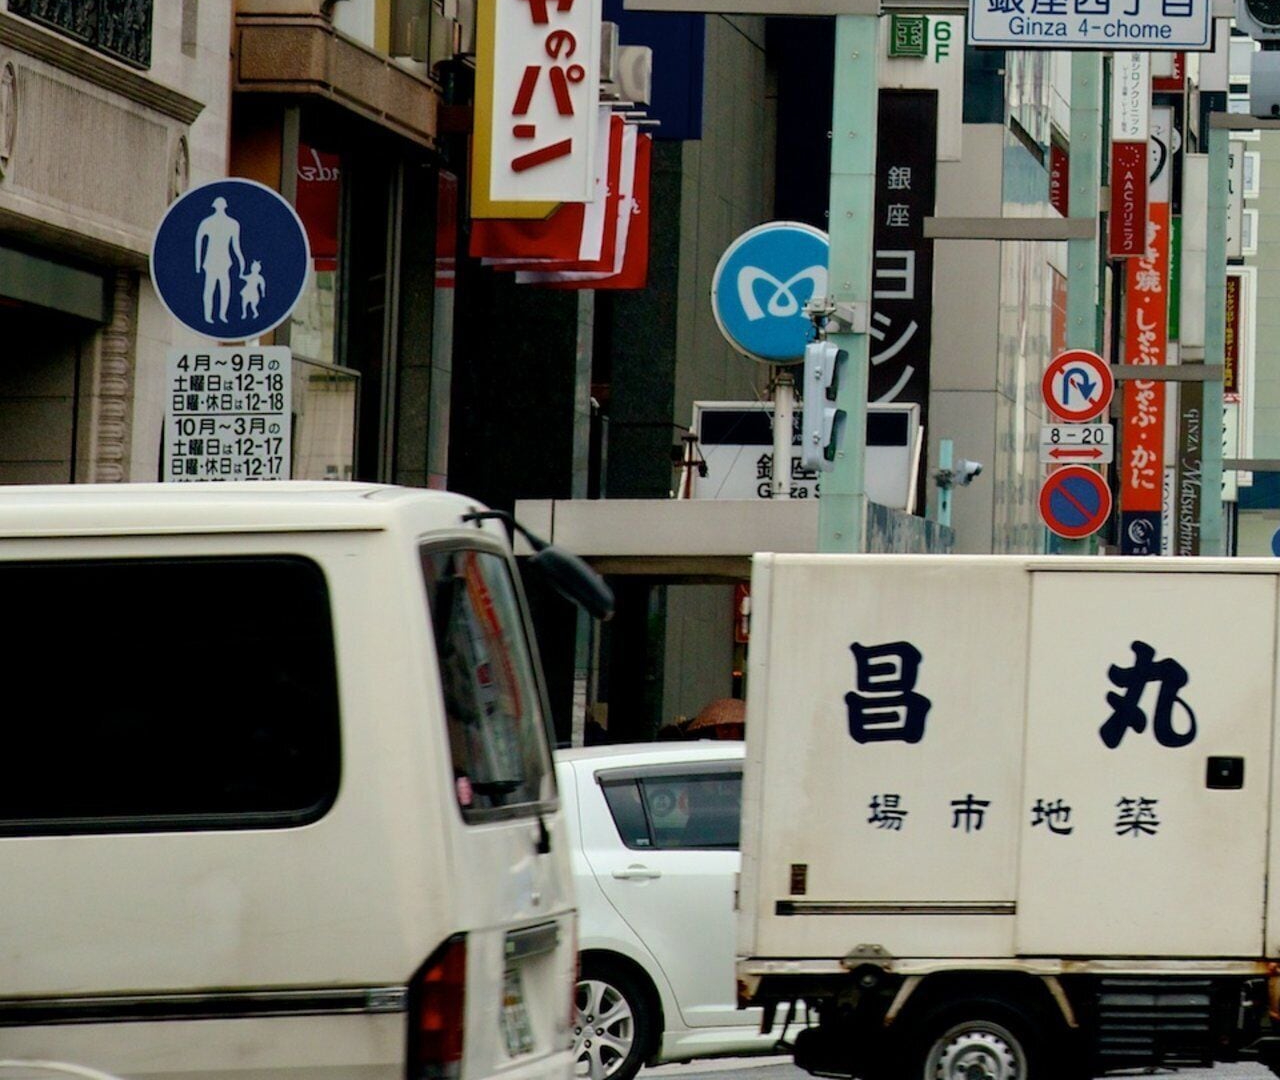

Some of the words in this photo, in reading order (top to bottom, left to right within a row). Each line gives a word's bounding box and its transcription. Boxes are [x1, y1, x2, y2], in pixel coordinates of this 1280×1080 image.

[934, 21, 951, 64] 6F
[1009, 18, 1068, 38] Ginza
[1078, 18, 1172, 40] 4-chome
[887, 166, 911, 227] 銀座
